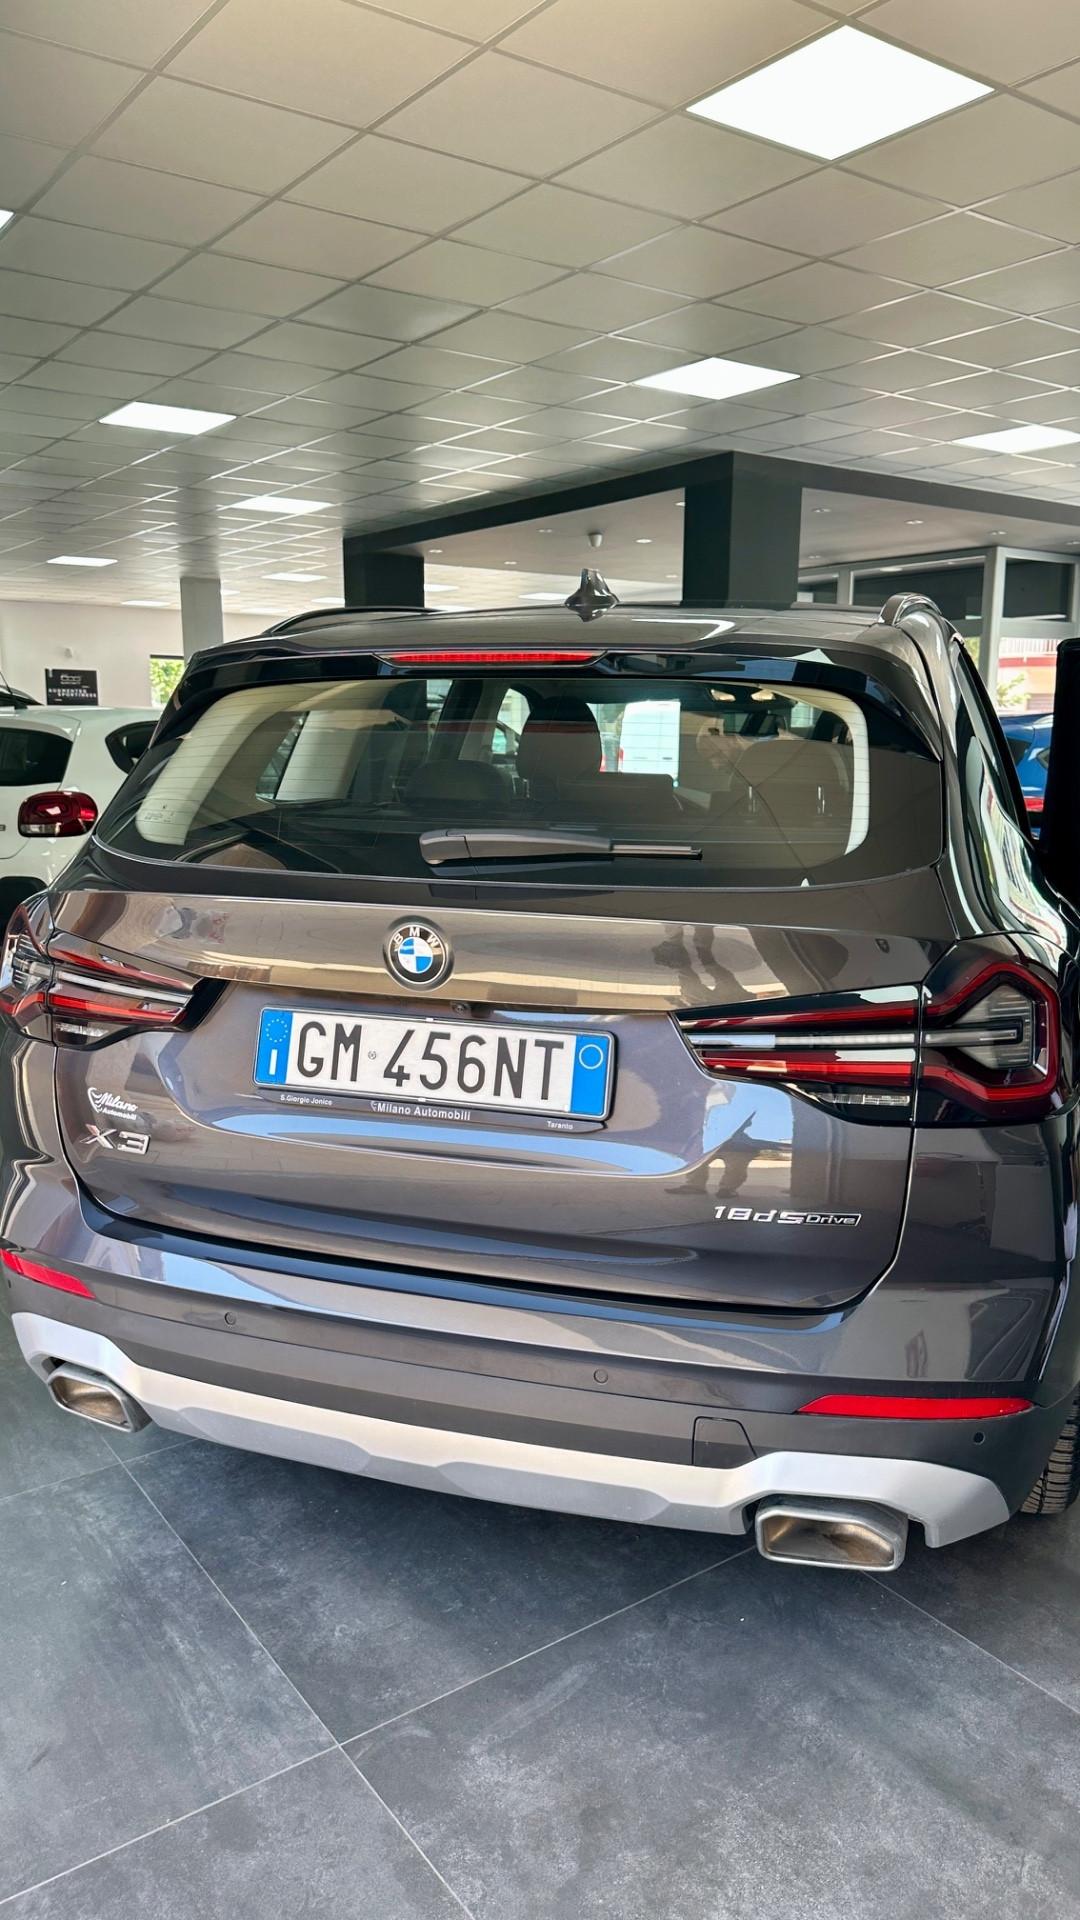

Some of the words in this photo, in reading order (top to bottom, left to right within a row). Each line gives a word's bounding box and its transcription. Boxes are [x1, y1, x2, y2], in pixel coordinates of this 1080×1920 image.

[393, 926, 440, 949] BMW
[296, 1020, 363, 1083] GM
[382, 1028, 565, 1101] 456NT
[99, 1091, 138, 1112] Milano
[377, 1102, 411, 1115] Milano
[413, 1106, 471, 1121] Automobili
[546, 1120, 574, 1130] Taranto
[79, 1123, 152, 1155] X3
